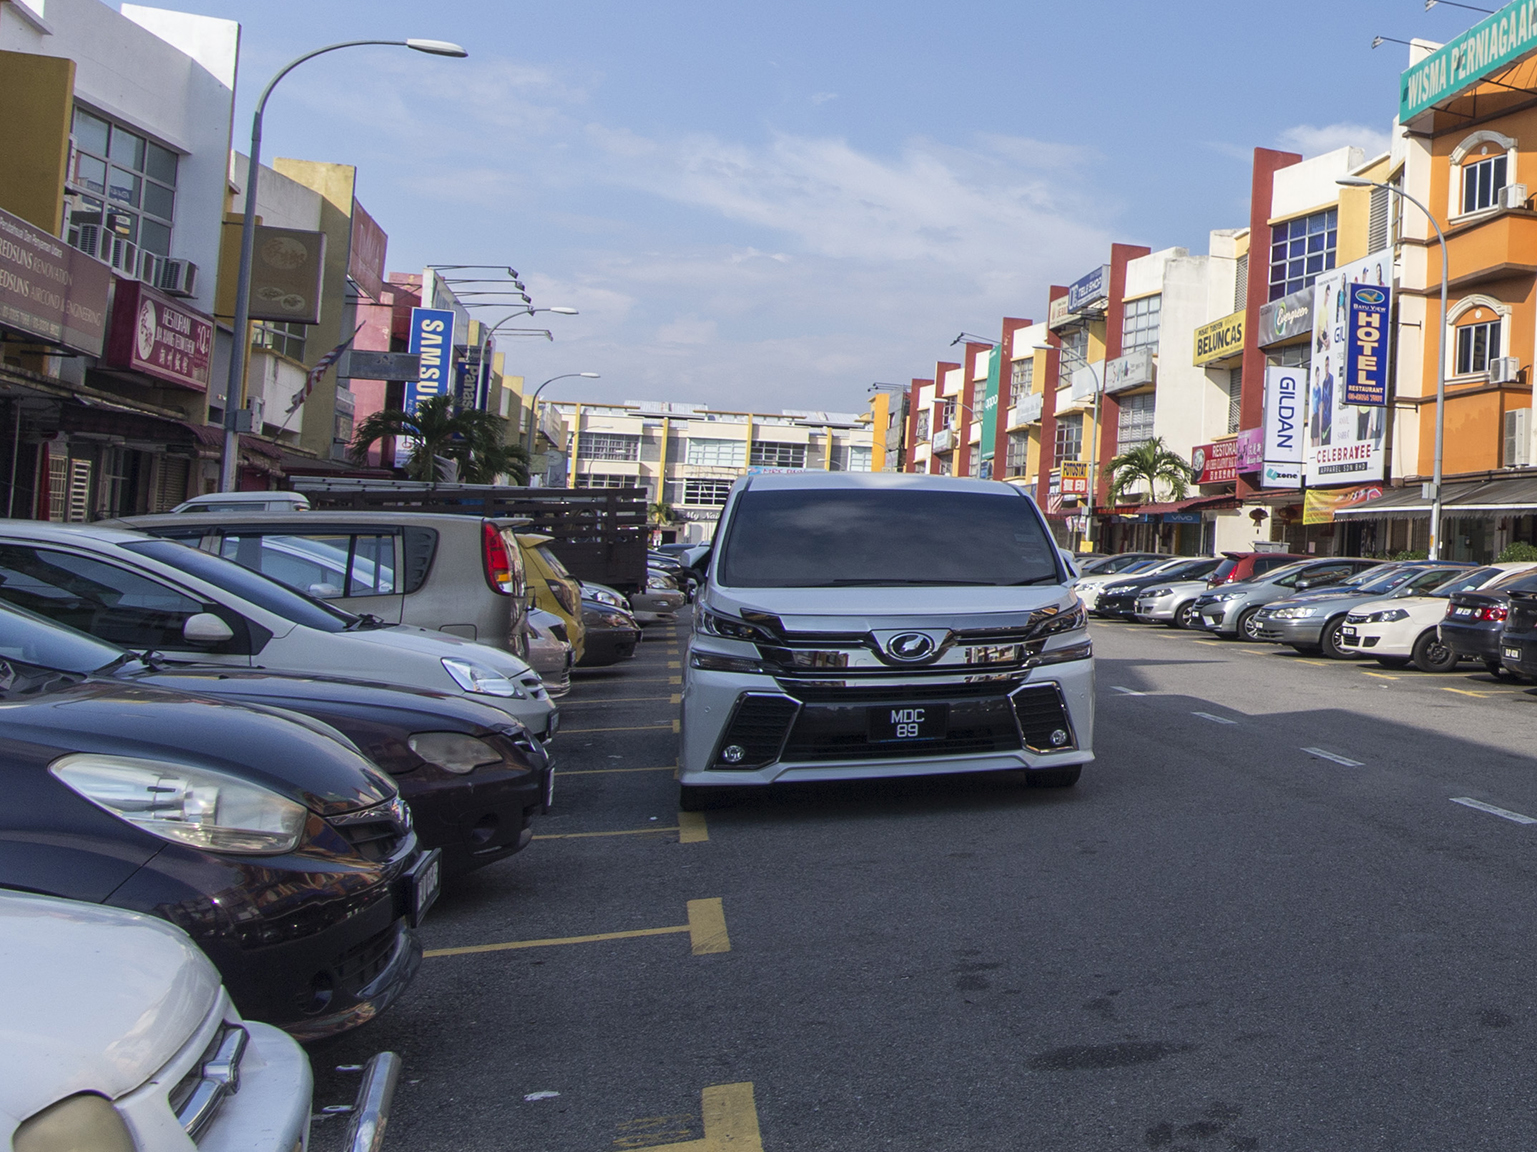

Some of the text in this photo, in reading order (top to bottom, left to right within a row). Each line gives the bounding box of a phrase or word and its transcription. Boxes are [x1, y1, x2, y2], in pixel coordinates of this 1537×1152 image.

[1408, 55, 1447, 110] WISMA
[0, 269, 29, 297] EDSUNS
[1197, 322, 1242, 356] BELUNCAS
[1357, 311, 1380, 386] HOTEL
[415, 319, 444, 422] SAMSU
[1276, 376, 1296, 449] GILDAN
[1320, 465, 1342, 474] APPAREL
[891, 708, 925, 723] MDC
[897, 724, 918, 737] 89
